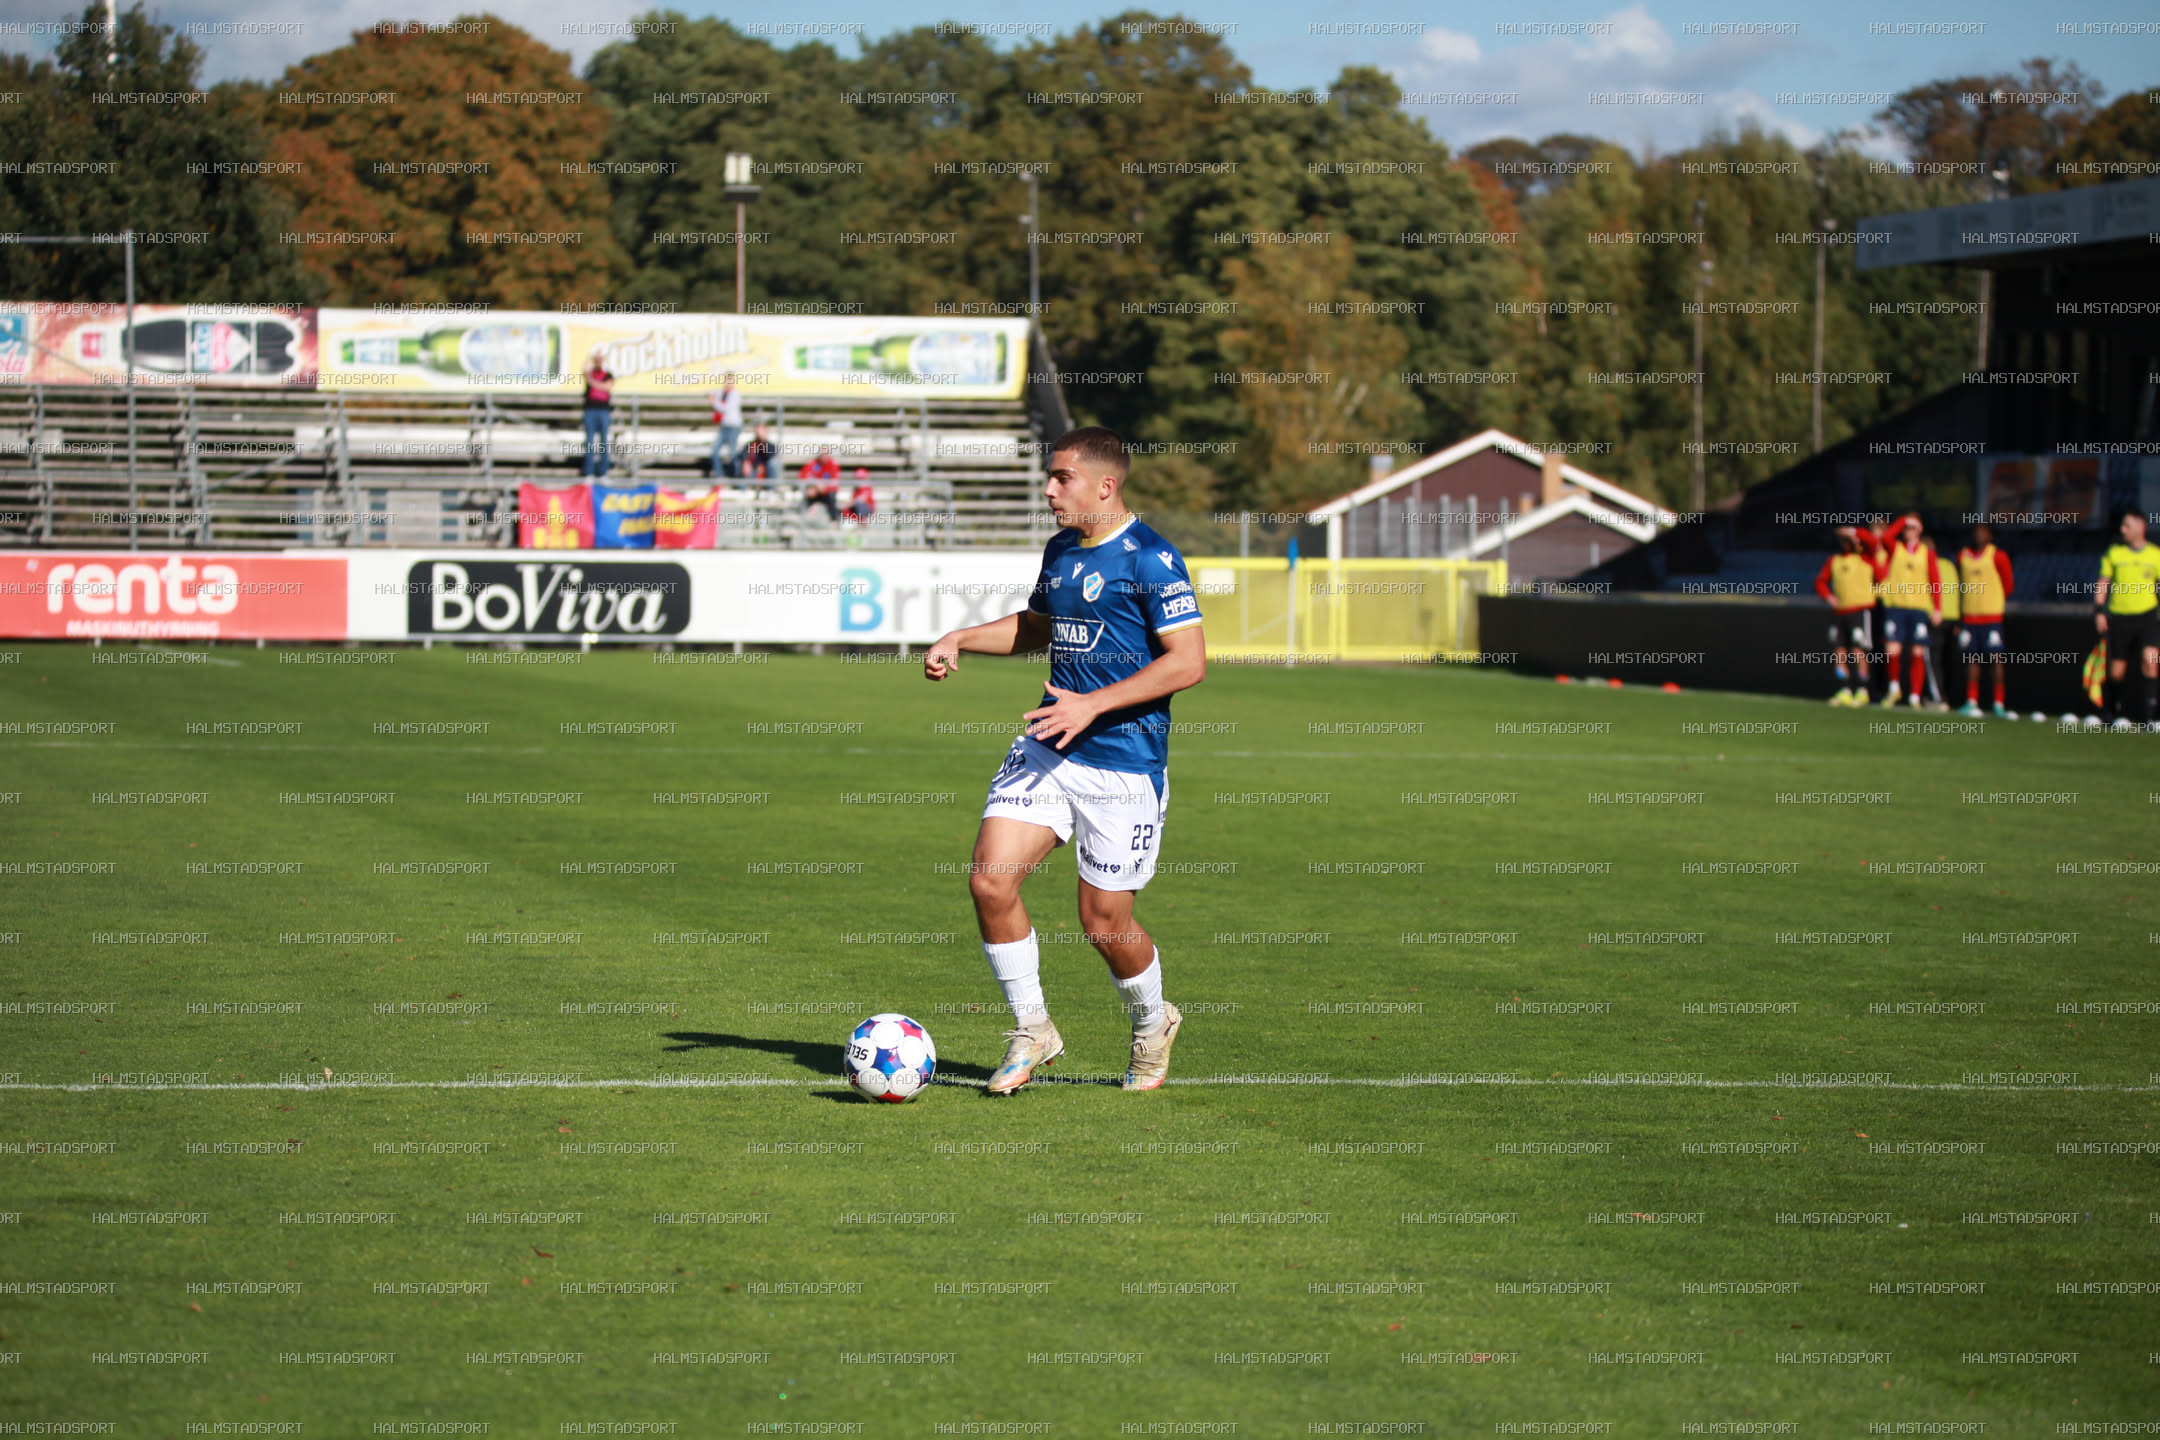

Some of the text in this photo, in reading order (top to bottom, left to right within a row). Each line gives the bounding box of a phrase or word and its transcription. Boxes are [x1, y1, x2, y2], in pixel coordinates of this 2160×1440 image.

[47, 556, 239, 614] renta
[431, 562, 668, 632] BoViva
[1162, 595, 1196, 616] HFAB
[1131, 824, 1154, 850] 22
